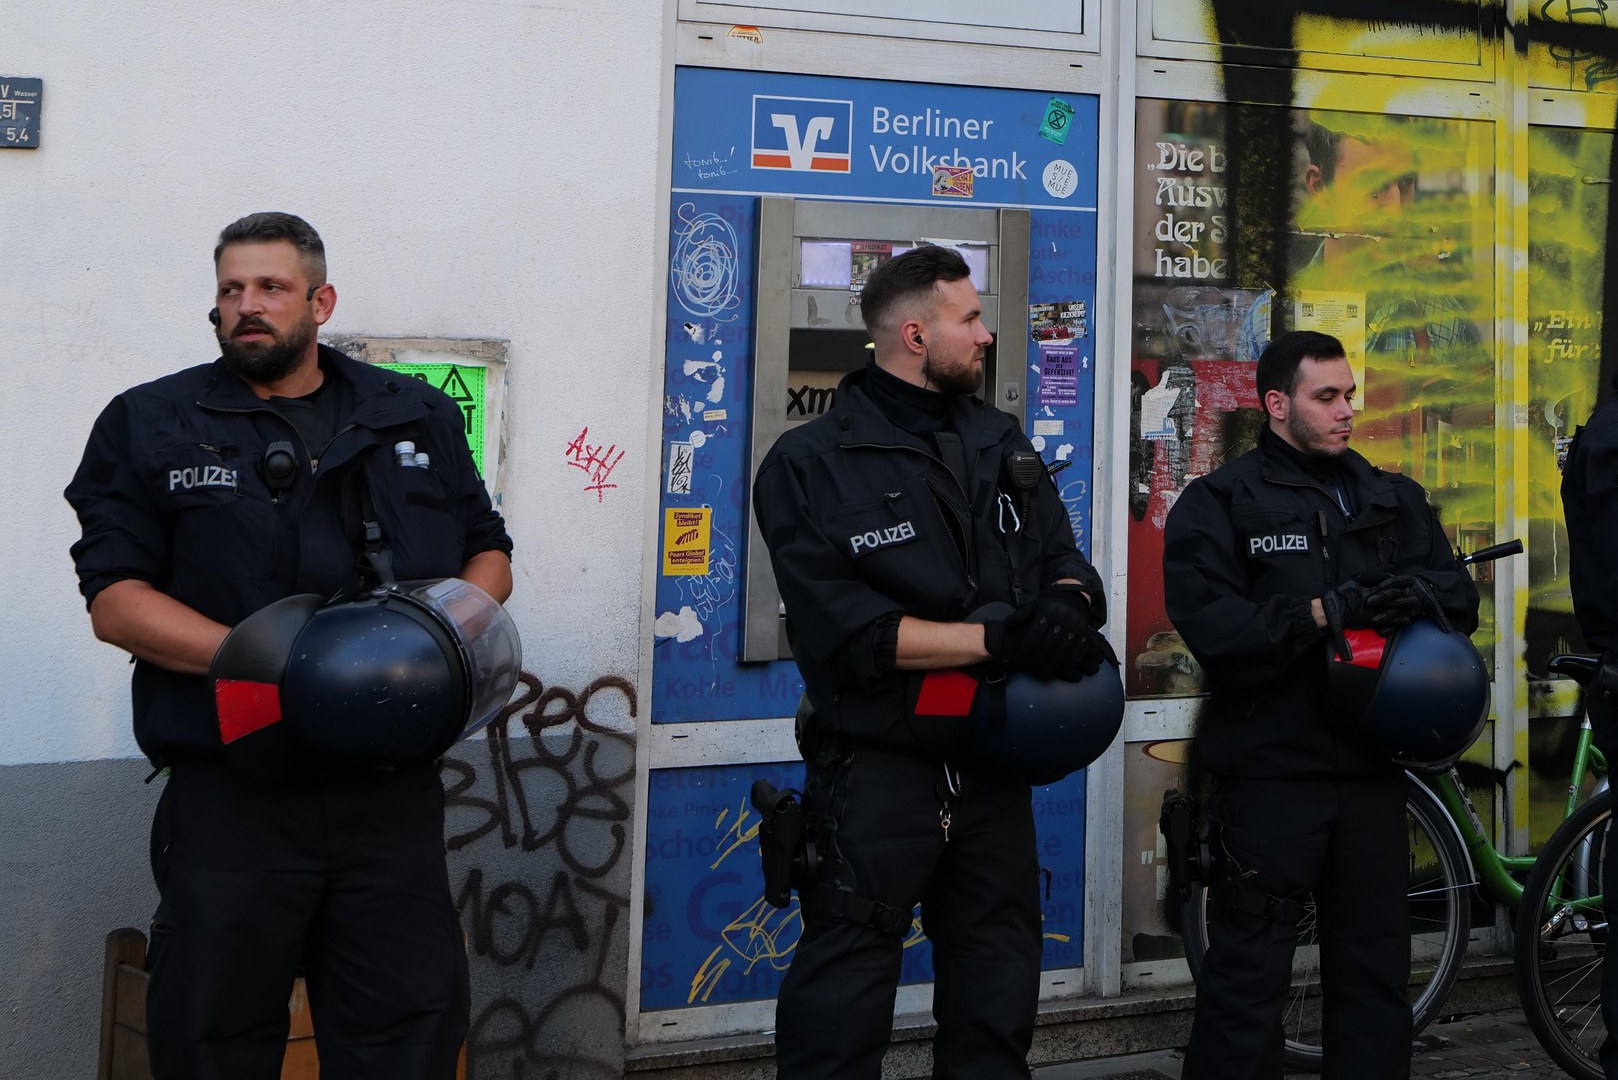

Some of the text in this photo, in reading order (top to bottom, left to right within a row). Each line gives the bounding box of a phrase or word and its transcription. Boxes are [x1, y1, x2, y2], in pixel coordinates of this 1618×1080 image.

[872, 106, 993, 140] Berliner
[6, 127, 29, 144] 5,4
[869, 144, 1028, 180] Volksbank
[1054, 163, 1073, 178] MUE
[1047, 180, 1067, 195] MUE
[1154, 213, 1206, 243] der
[1543, 338, 1589, 364] für
[168, 465, 237, 491] POLIZEI
[675, 512, 702, 520] Syndikat
[850, 520, 917, 553] POLIZEI
[1249, 534, 1309, 555] POLIZEI
[685, 549, 705, 557] Global
